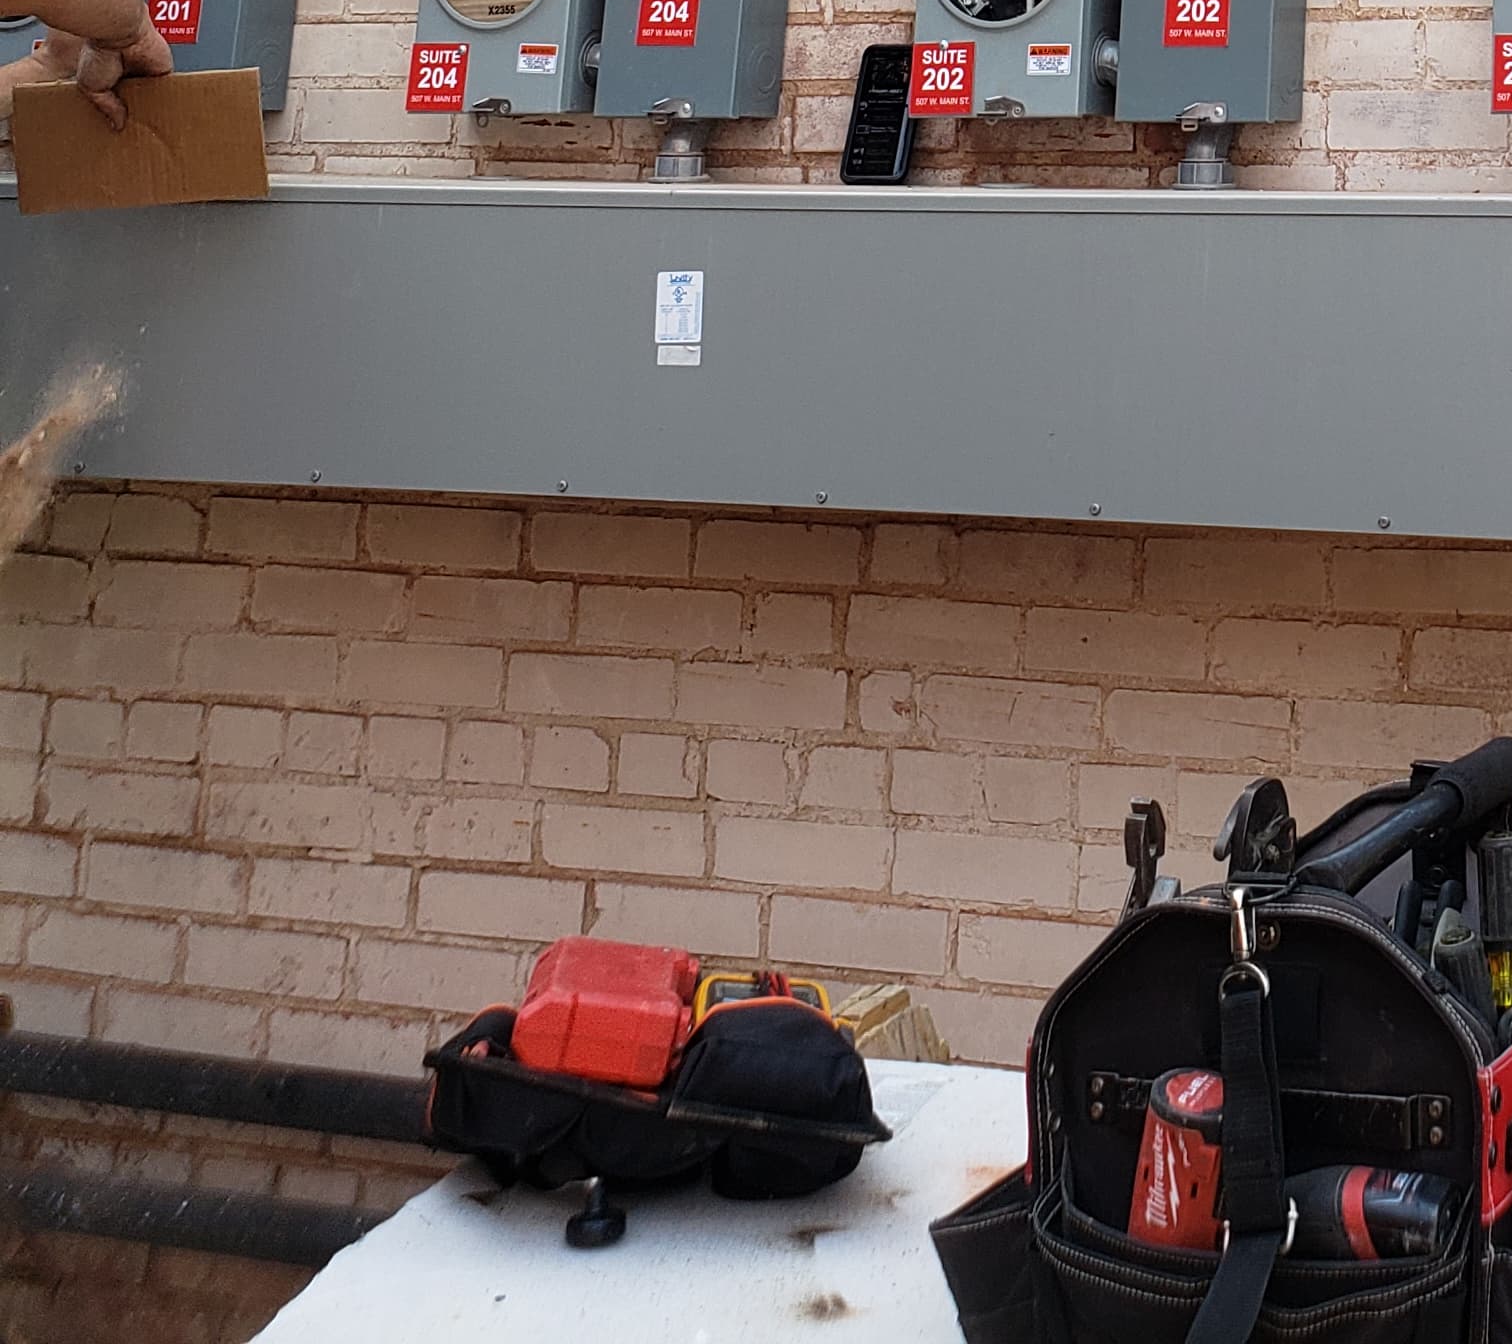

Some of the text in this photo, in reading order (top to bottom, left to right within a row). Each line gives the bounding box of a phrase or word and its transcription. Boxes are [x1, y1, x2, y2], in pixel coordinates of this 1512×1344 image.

[154, 0, 191, 21] 201
[488, 4, 516, 16] X2355
[648, 0, 689, 23] 204
[664, 29, 683, 37] MAIN
[1194, 29, 1214, 38] MAIN
[419, 49, 461, 64] SUITE
[922, 49, 968, 64] SUITE
[417, 67, 458, 89] 204
[921, 67, 964, 91] 202
[433, 95, 451, 103] MAIN
[915, 97, 929, 106] 507
[939, 96, 958, 105] MAIN
[1496, 92, 1511, 102] 507
[1177, 1073, 1209, 1105] FUEL
